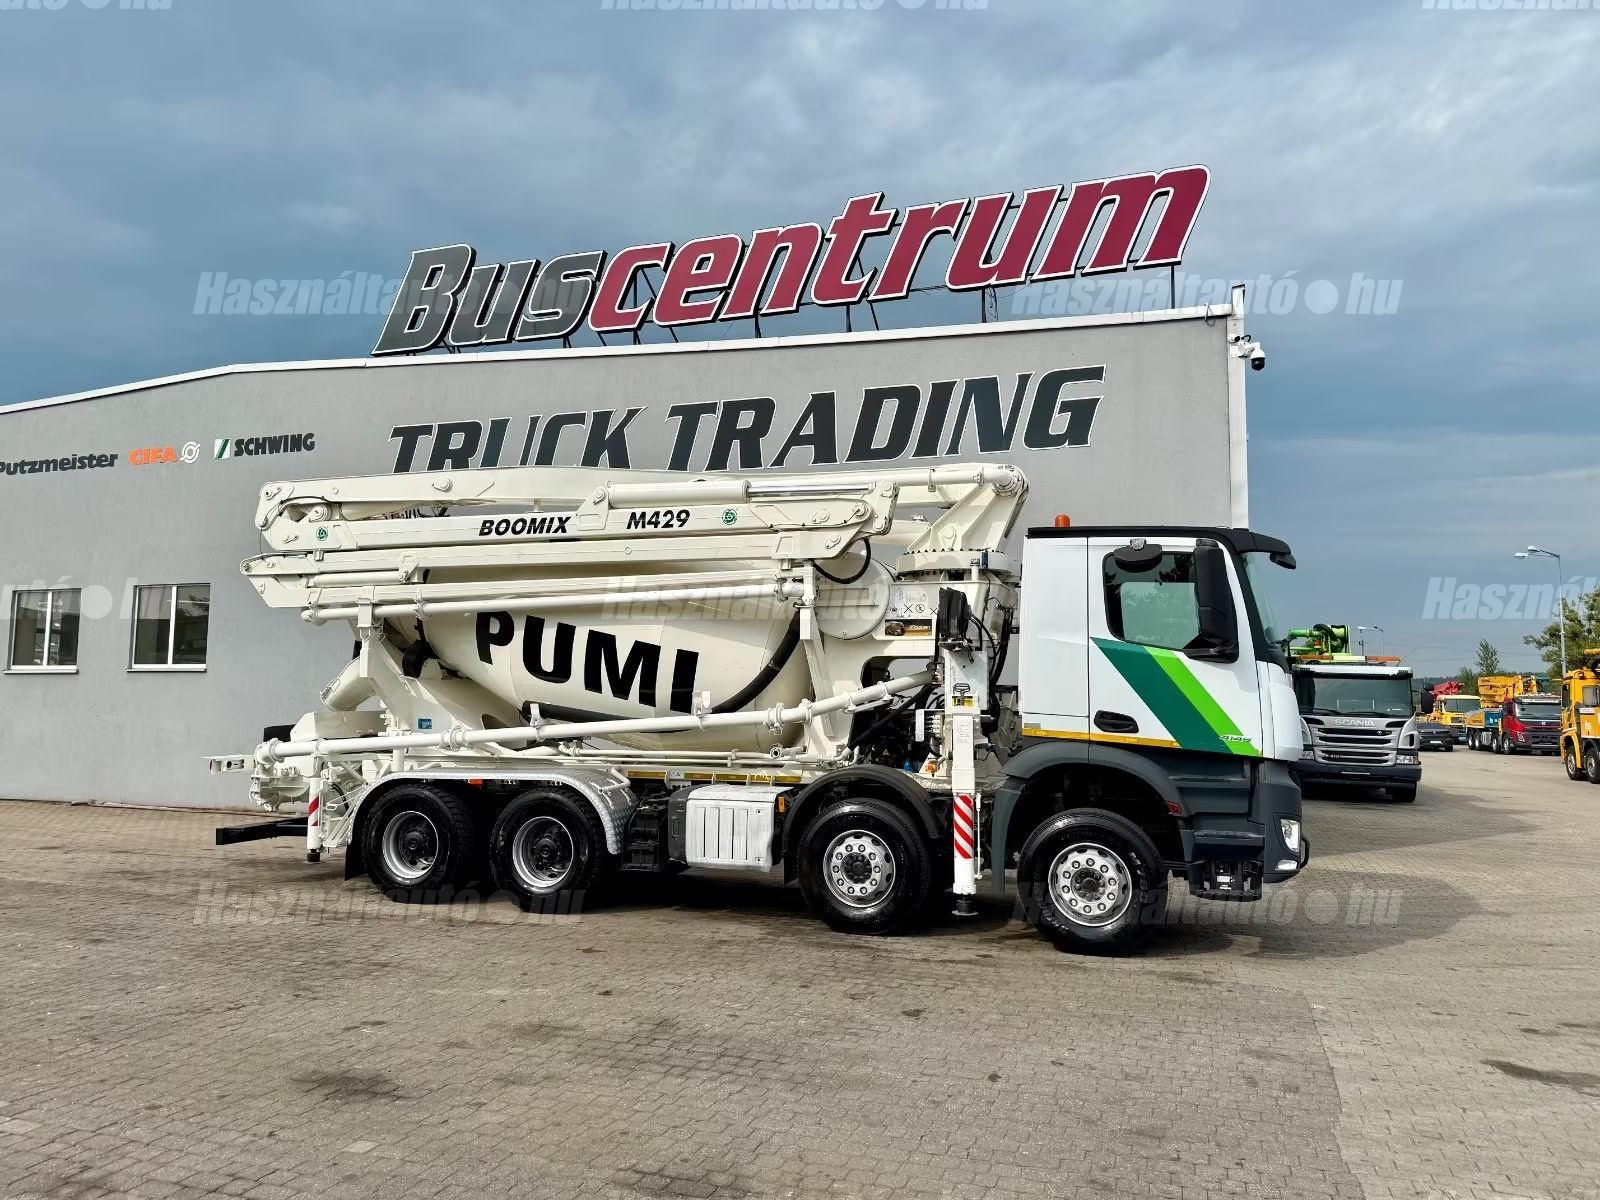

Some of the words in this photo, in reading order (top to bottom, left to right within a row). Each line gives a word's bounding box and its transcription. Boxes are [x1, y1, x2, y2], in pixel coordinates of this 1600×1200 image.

[370, 164, 1211, 356] Buscentrum
[387, 406, 648, 474] TRUCK
[664, 364, 1107, 471] TRADING
[128, 446, 177, 465] CIFA
[233, 432, 316, 457] SCHWING
[478, 516, 572, 537] BOOMIX
[626, 508, 691, 530] M429
[476, 611, 699, 715] PUMI
[1334, 719, 1375, 727] SCANIA
